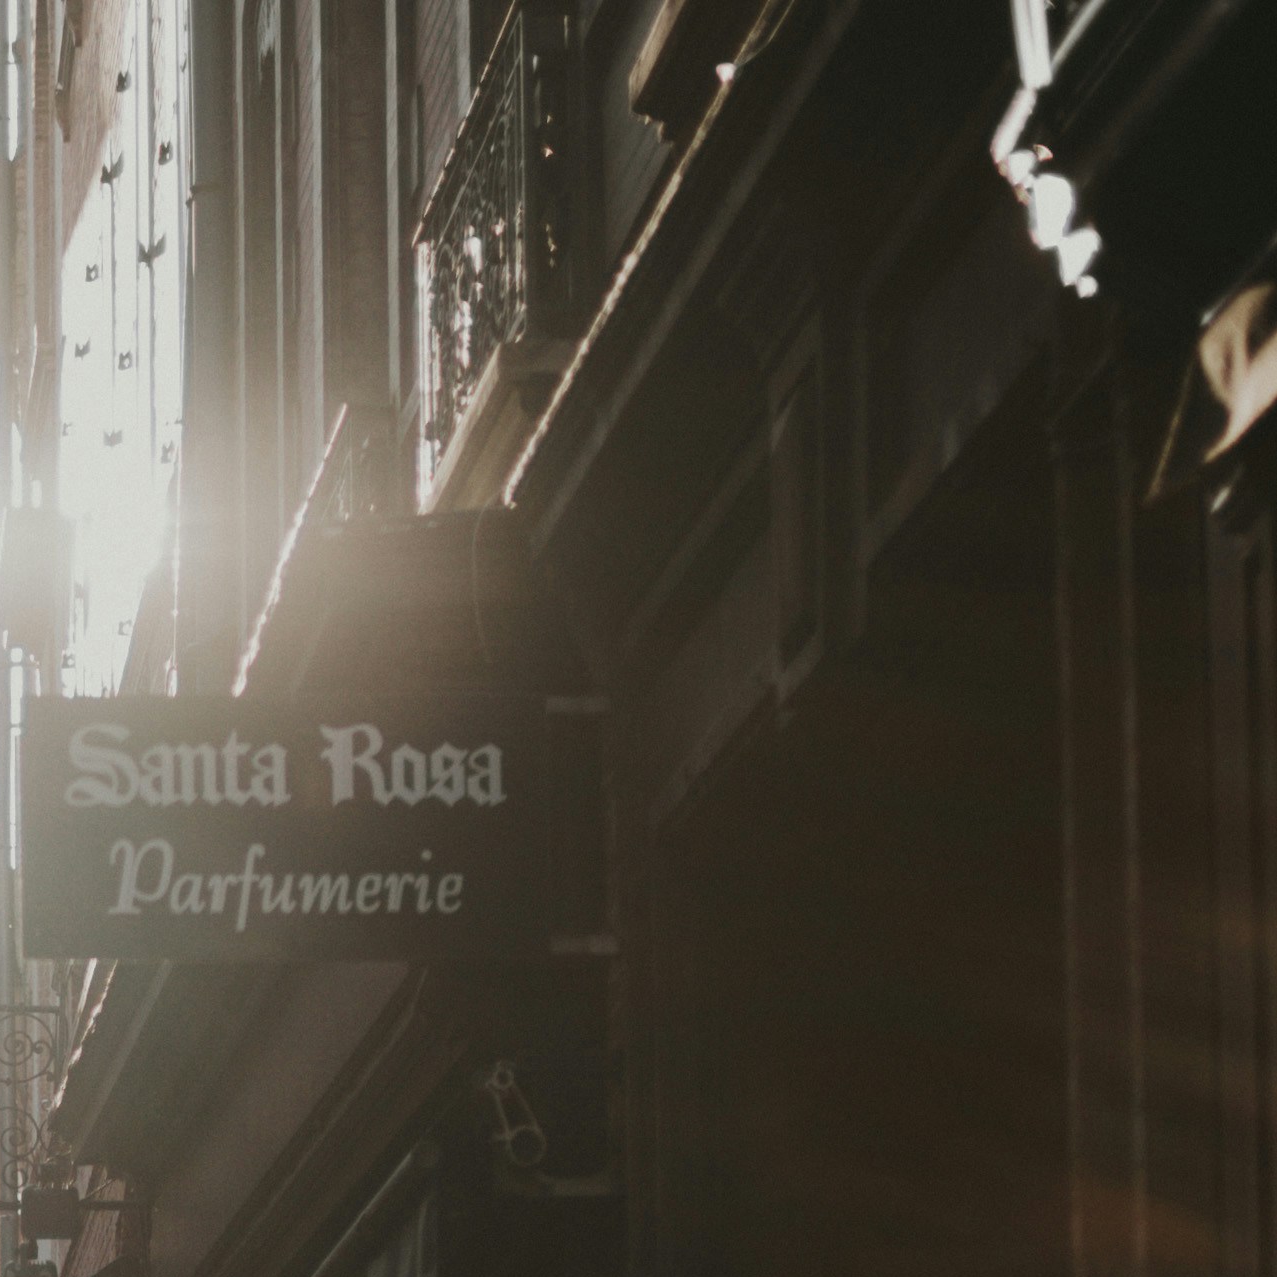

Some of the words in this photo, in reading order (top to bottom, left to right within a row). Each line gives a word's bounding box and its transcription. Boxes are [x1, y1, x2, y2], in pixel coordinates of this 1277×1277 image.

[66, 722, 291, 807] Santa
[319, 722, 507, 807] Rosa
[108, 837, 465, 932] Parfumerie
